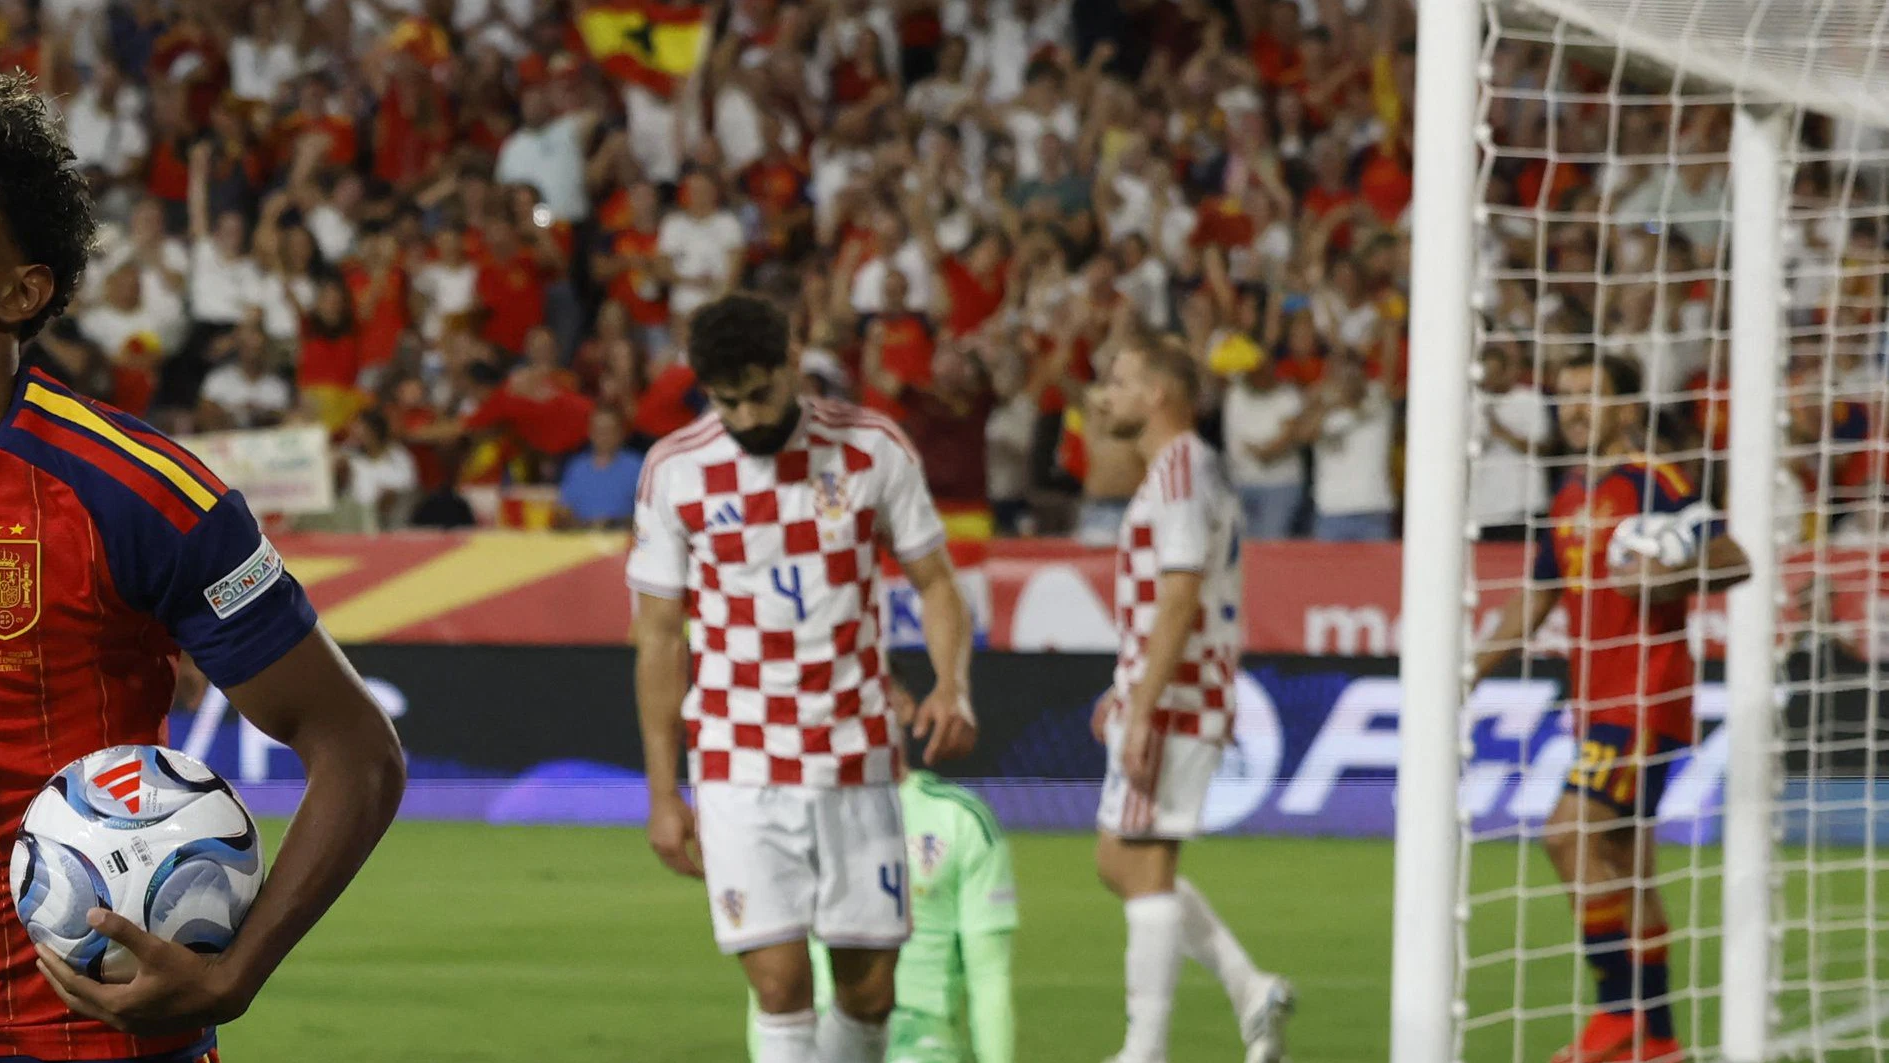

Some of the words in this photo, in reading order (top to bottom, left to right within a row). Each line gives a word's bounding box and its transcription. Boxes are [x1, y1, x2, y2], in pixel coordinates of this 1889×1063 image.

[207, 581, 230, 598] UEFA
[771, 565, 807, 622] 4
[1569, 740, 1617, 792] 21
[879, 860, 904, 918] 4
